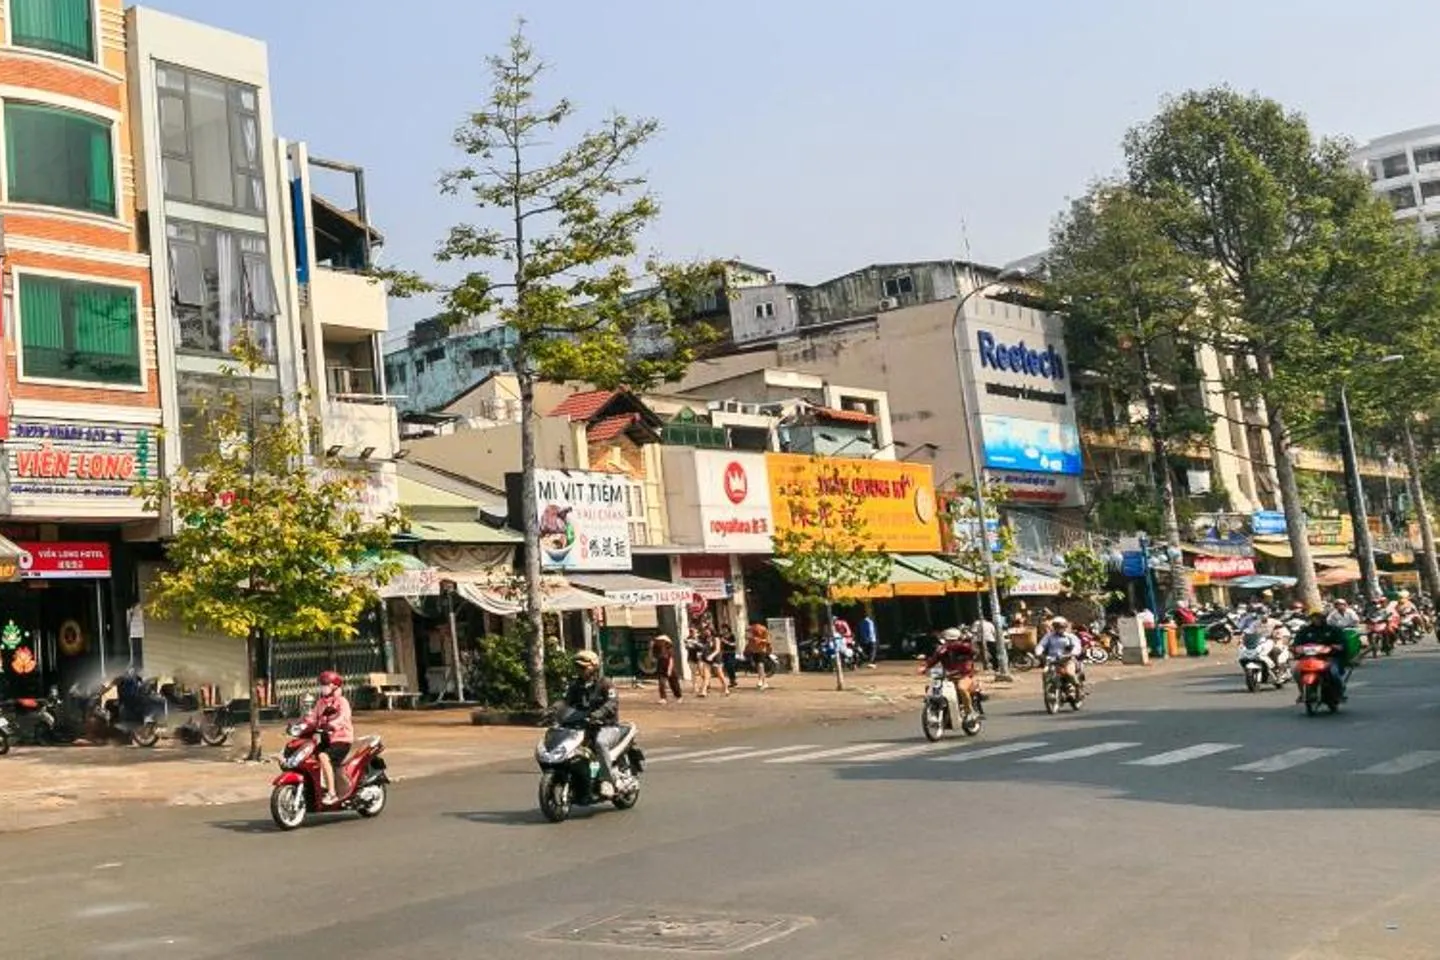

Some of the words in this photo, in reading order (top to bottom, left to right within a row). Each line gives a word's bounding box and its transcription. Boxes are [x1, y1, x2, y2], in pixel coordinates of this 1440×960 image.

[977, 330, 1065, 380] Reetech
[75, 453, 136, 480] LONG
[81, 550, 104, 559] HOTEL
